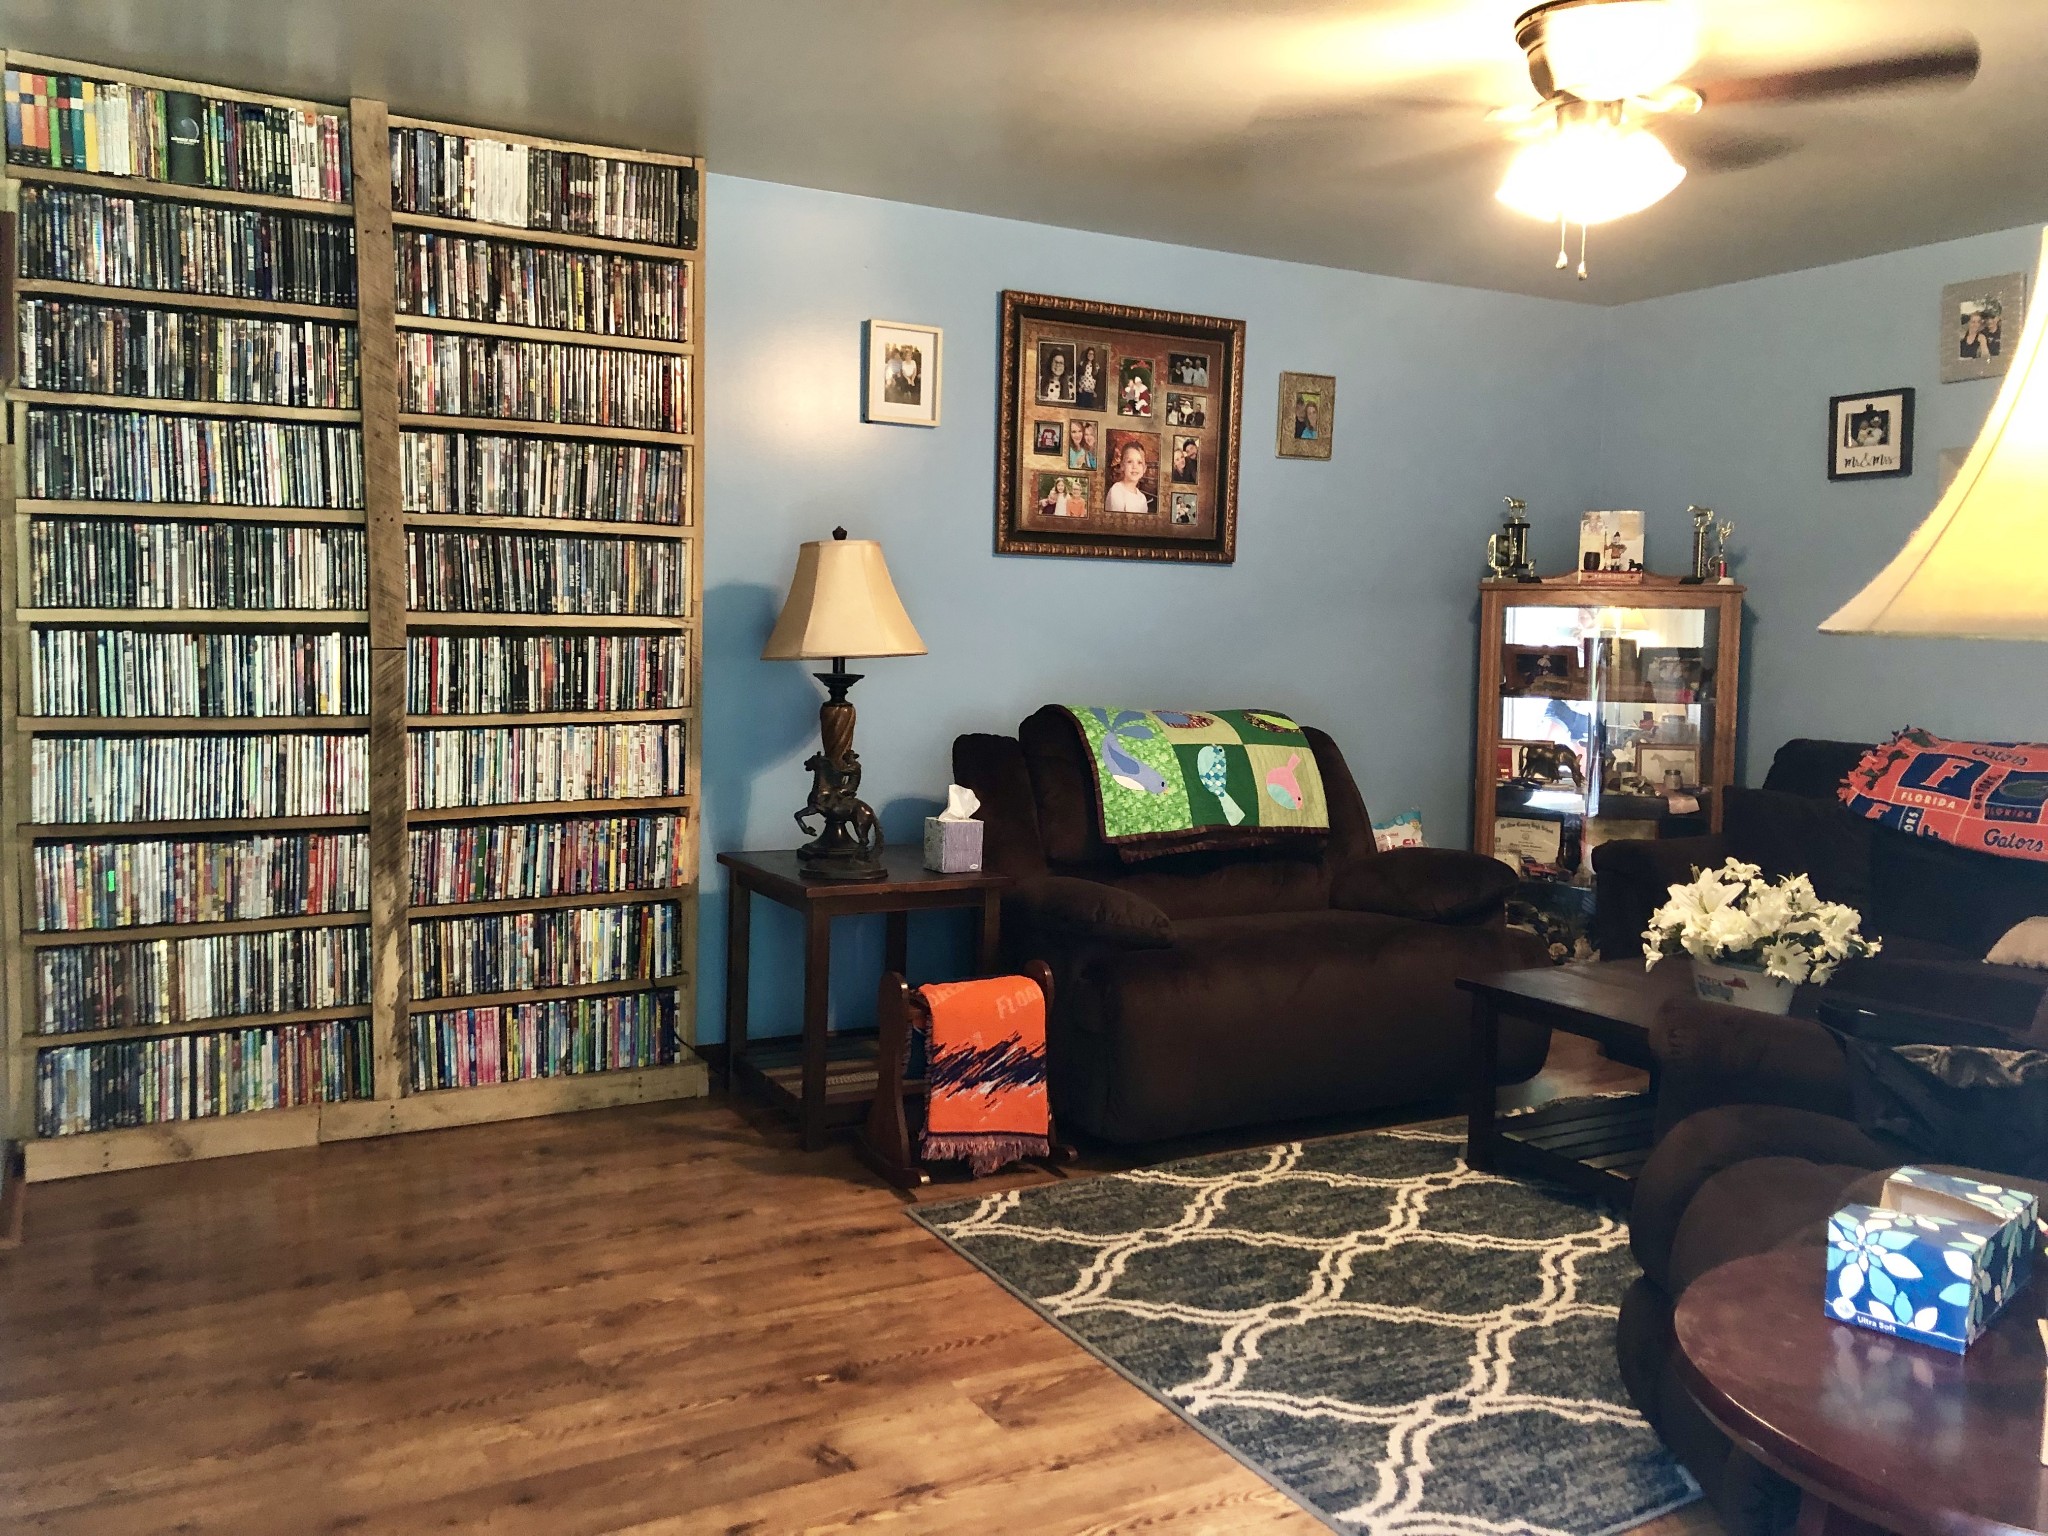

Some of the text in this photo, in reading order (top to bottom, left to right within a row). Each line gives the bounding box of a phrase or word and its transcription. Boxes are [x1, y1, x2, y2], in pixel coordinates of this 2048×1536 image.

[1900, 791, 1957, 810] FLORIDA
[1983, 827, 2046, 853] Gators
[1856, 1315, 1878, 1328] Ultra
[1878, 1321, 1897, 1333] Soft
